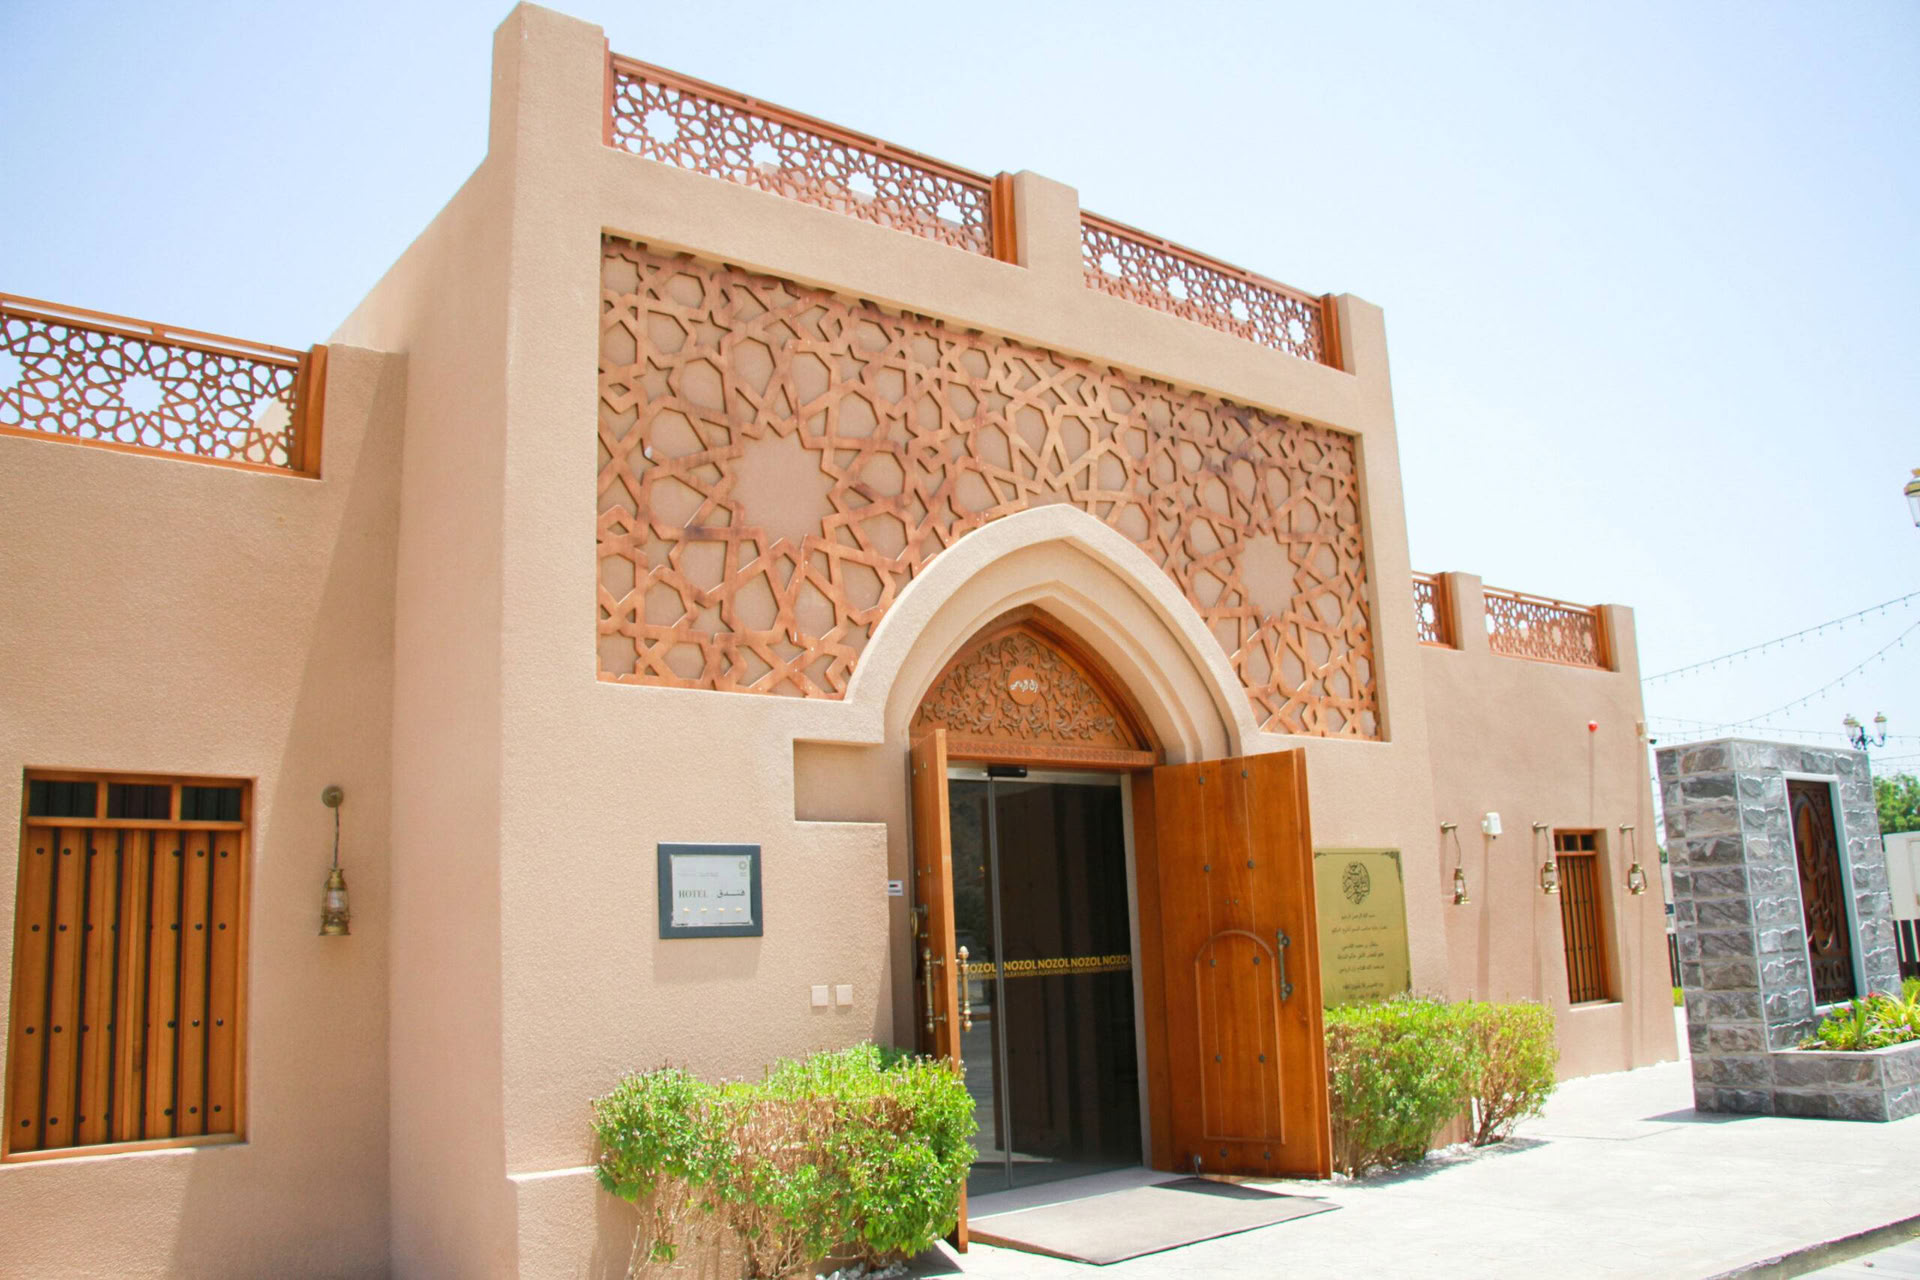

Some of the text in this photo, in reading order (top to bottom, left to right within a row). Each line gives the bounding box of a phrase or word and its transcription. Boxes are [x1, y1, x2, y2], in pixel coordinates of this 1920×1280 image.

[678, 889, 708, 899] HOTEL
[717, 888, 745, 899] فندق
[967, 962, 997, 974] OZOL
[1003, 960, 1037, 971] NOZOL
[1038, 958, 1070, 969] NOZOL
[1070, 956, 1103, 968] NOZOL
